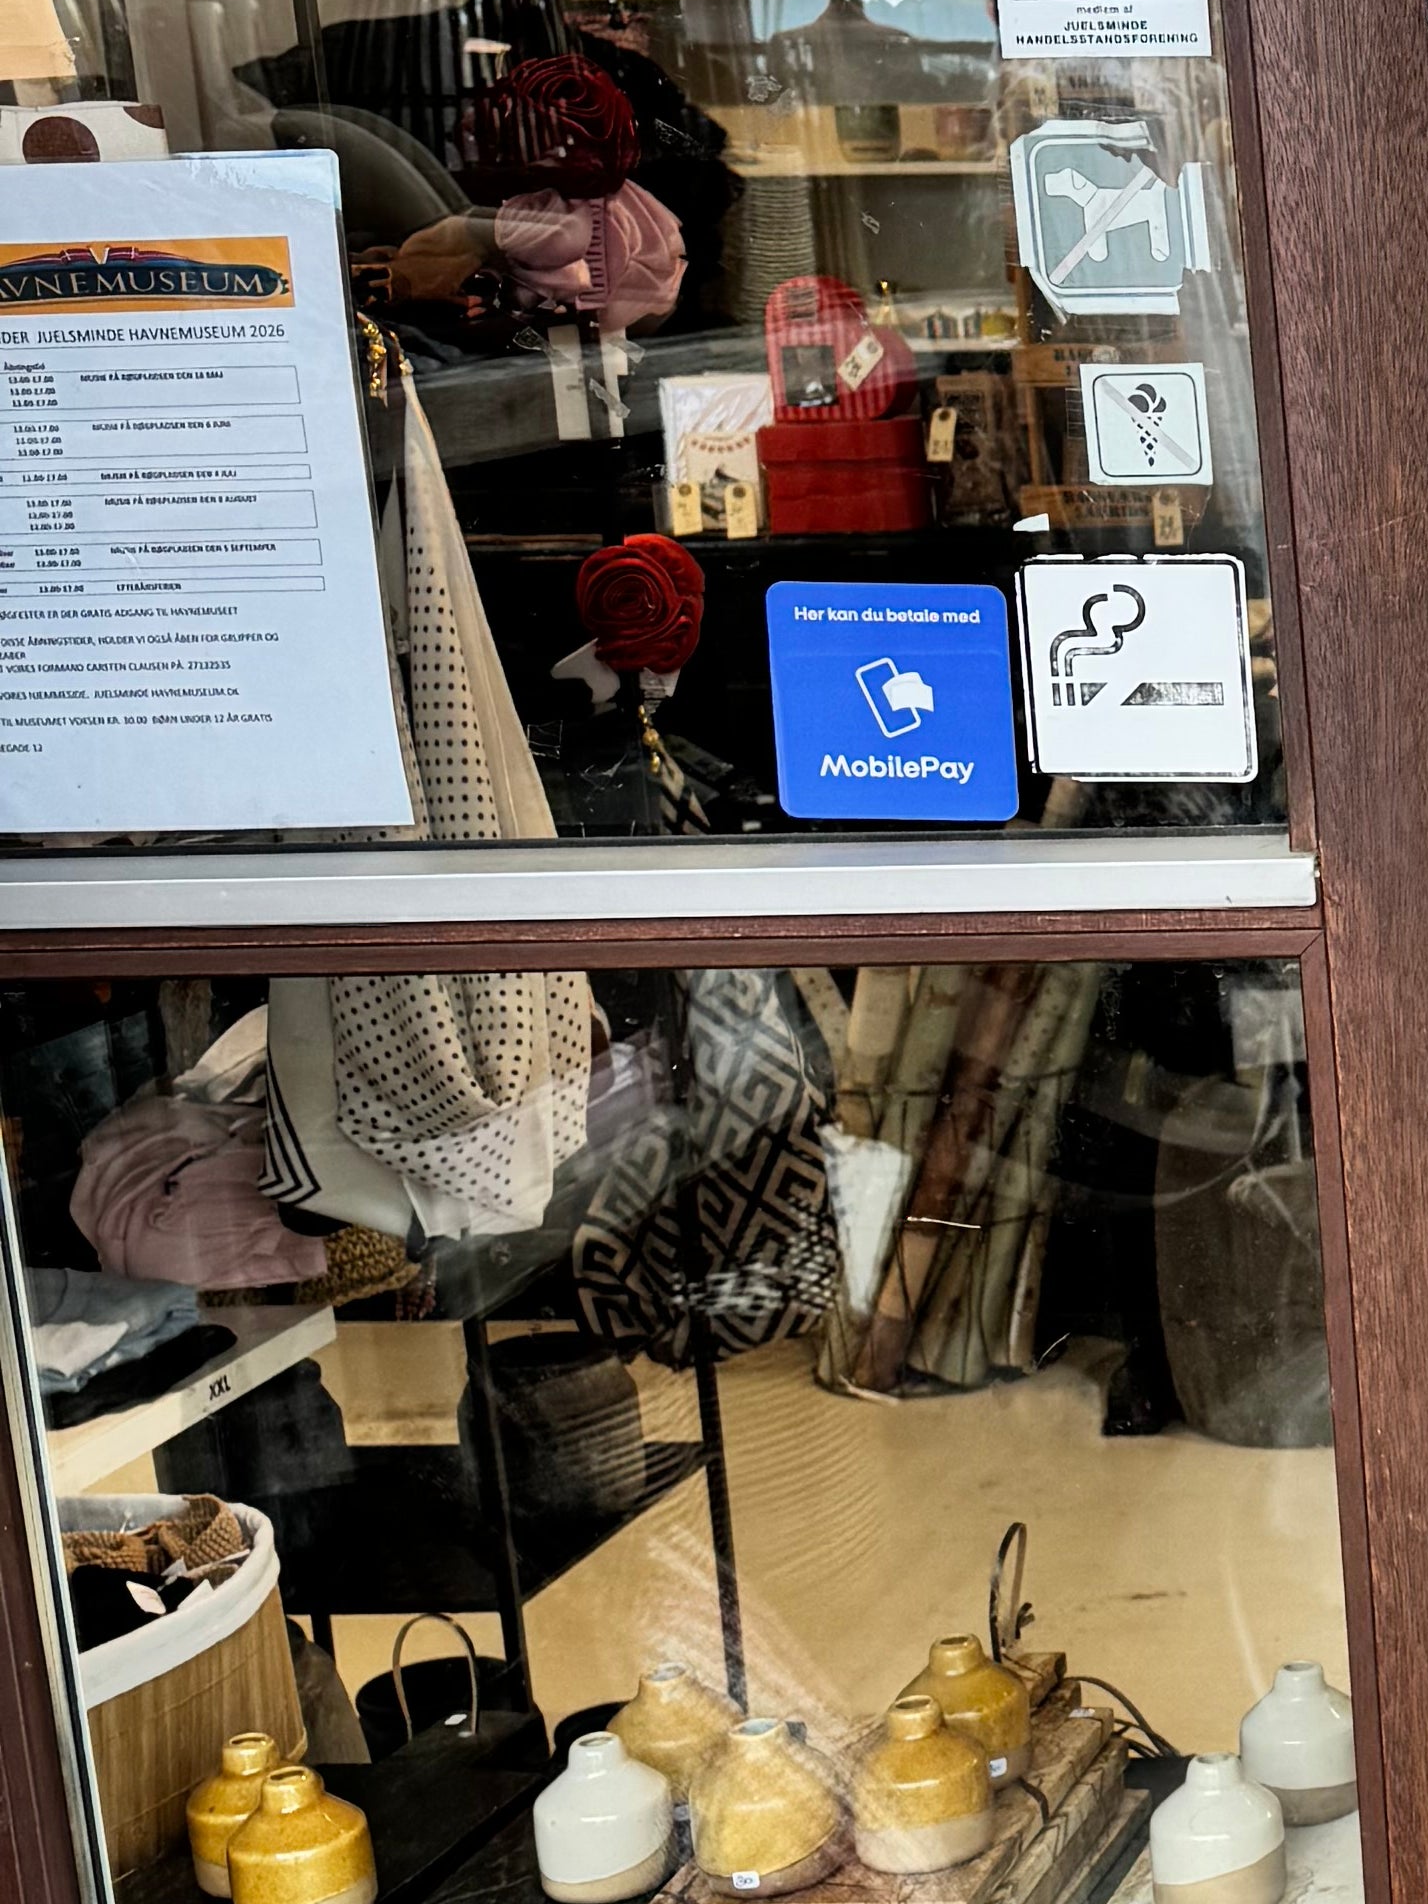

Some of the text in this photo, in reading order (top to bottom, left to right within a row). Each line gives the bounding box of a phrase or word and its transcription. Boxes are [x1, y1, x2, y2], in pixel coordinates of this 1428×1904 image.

[1063, 19, 1148, 32] JUELSMINDE
[1015, 33, 1198, 46] HANDELSSTANDSFORENING
[37, 324, 285, 345] JUELSMINDE HAVNEMUSEUM 2026
[794, 605, 981, 624] Her kan du betale med
[819, 754, 975, 785] MobilePay
